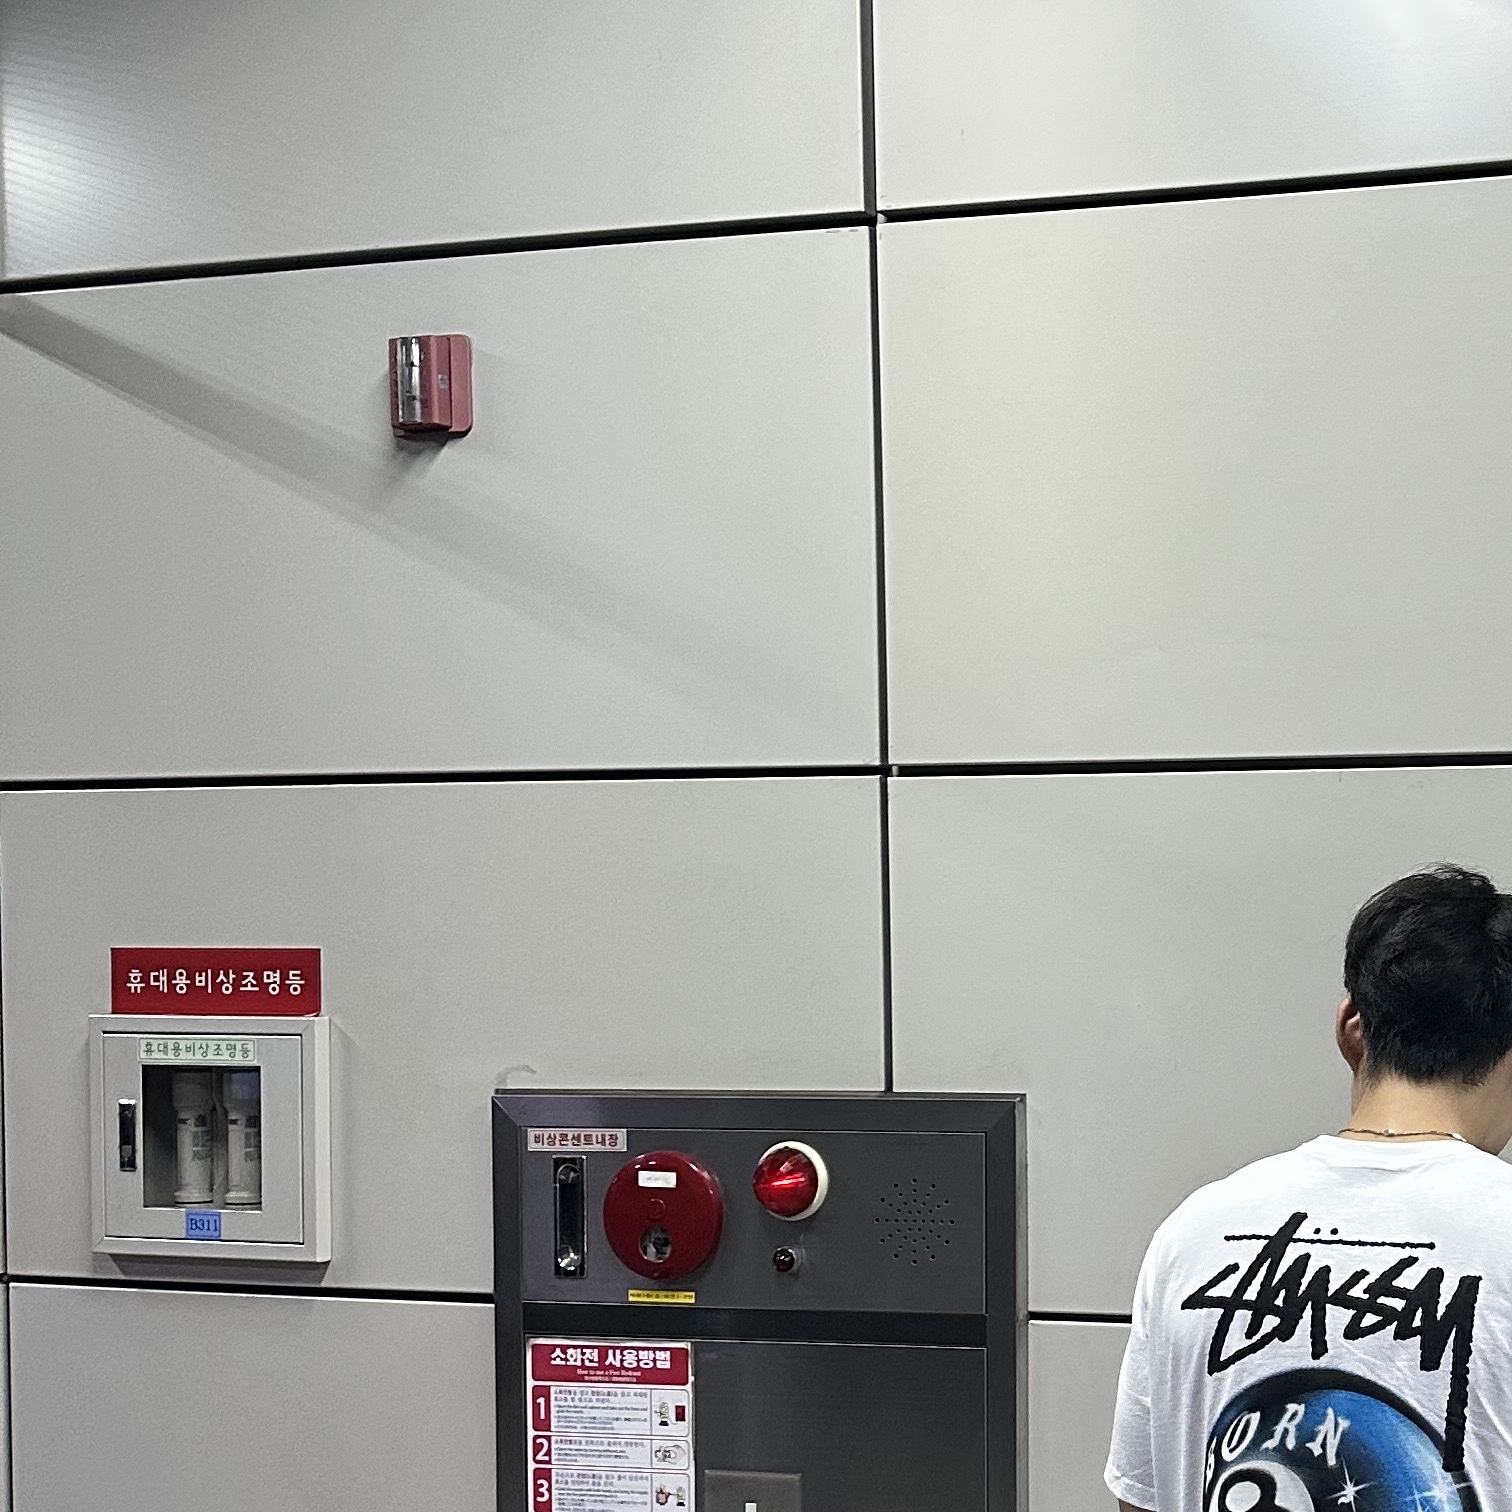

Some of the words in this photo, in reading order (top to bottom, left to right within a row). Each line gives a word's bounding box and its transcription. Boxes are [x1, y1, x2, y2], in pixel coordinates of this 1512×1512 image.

[126, 968, 305, 995] 휴대용비상조명등
[143, 1041, 251, 1058] 휴대용비상조명등
[534, 1133, 618, 1147] 비상콘센트내장
[189, 1218, 219, 1231] B311
[550, 1347, 599, 1367] 소화전
[605, 1349, 671, 1369] 사용방법
[536, 1397, 546, 1420] 1
[535, 1438, 550, 1461] 2
[536, 1479, 550, 1502] 3
